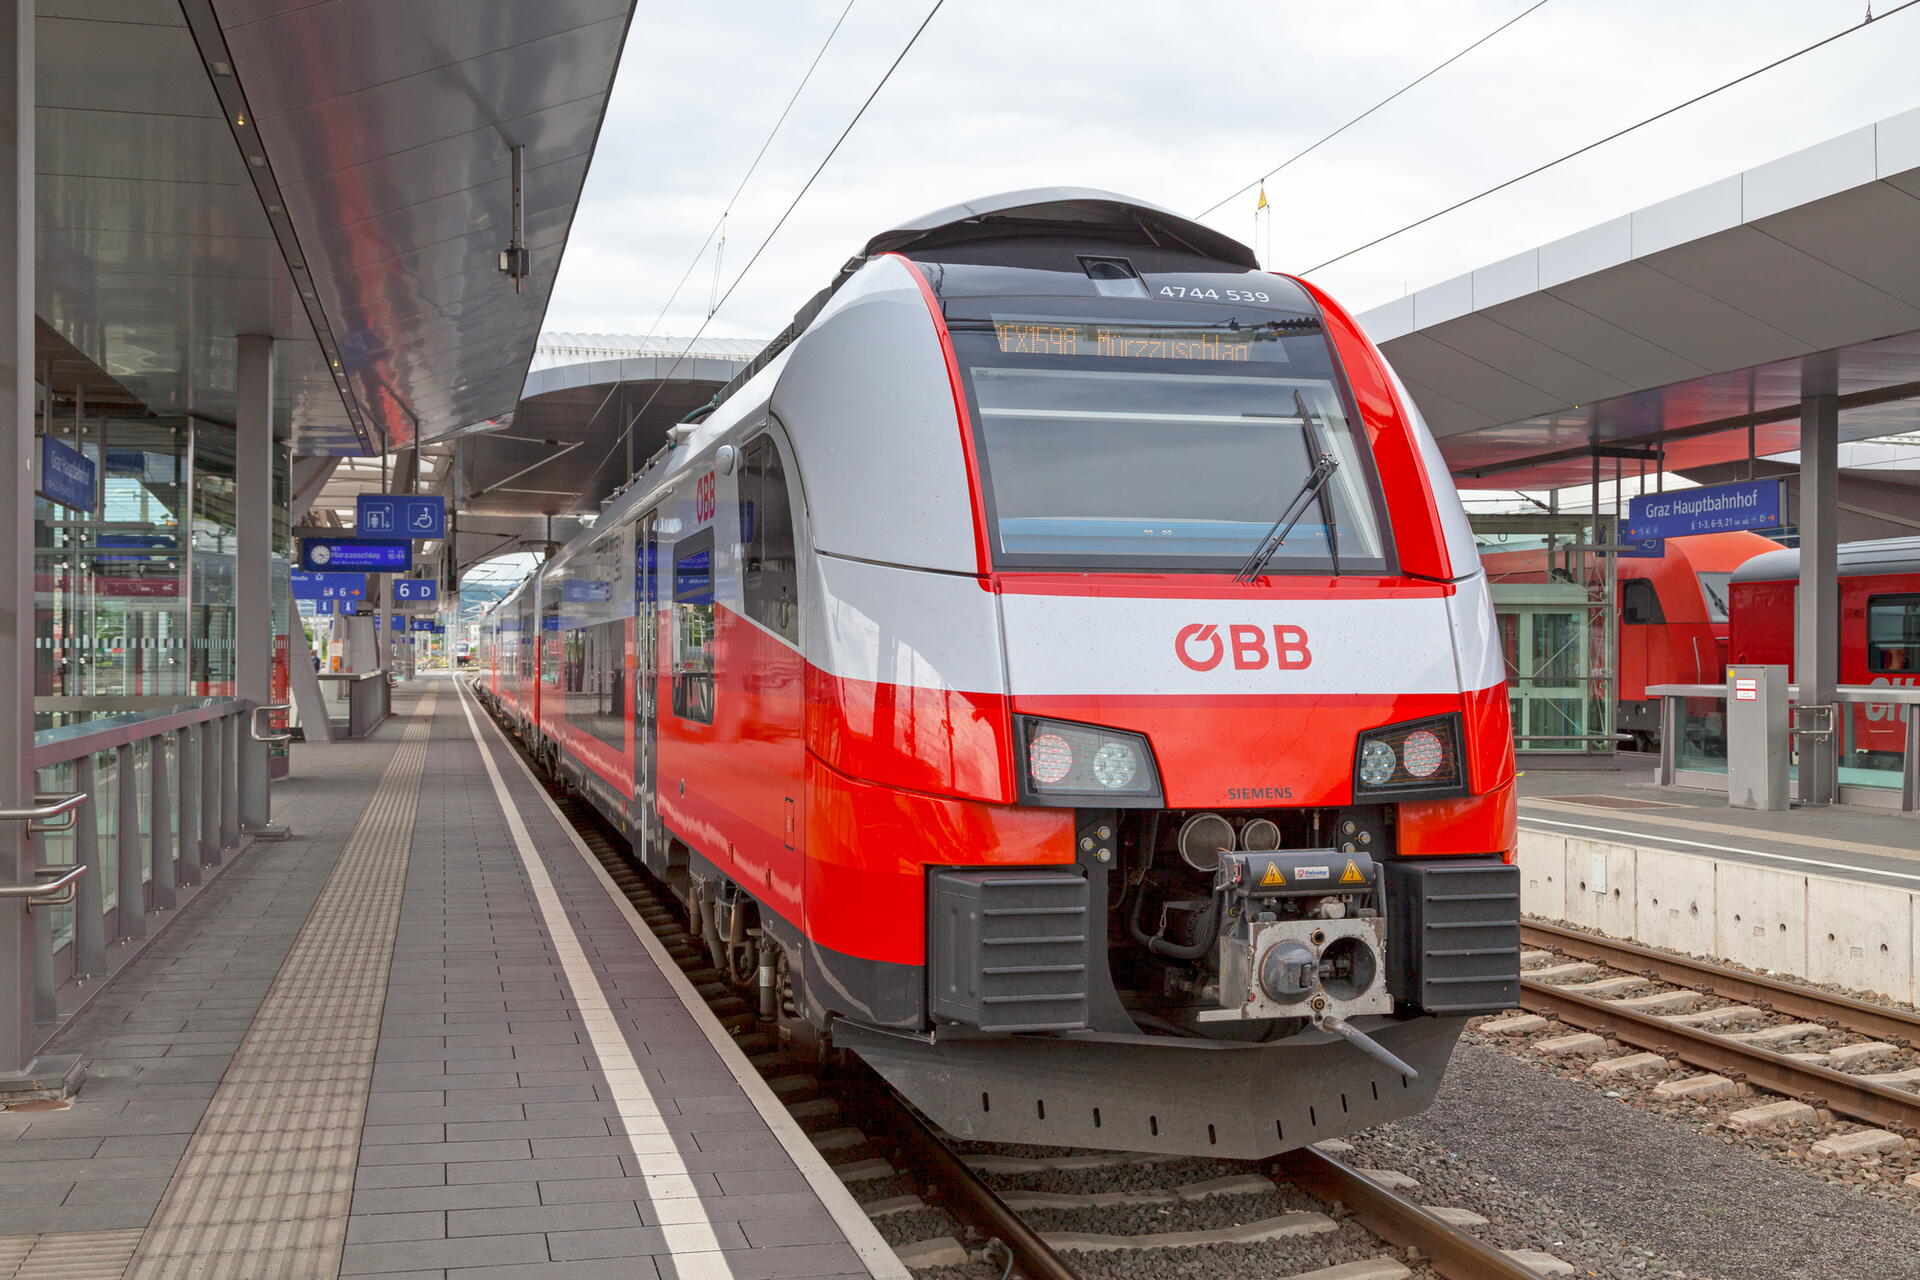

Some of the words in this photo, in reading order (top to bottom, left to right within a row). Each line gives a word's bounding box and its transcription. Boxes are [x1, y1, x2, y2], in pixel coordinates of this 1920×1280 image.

[1160, 286, 1219, 300] 4744
[1226, 290, 1270, 303] 539
[696, 470, 715, 525] ÖBB
[1645, 503, 1671, 519] Graz
[1673, 489, 1759, 517] Hauptbahnhof
[339, 587, 347, 597] 6
[400, 583, 410, 598] 6
[421, 586, 431, 597] D
[413, 621, 420, 630] 6
[1175, 623, 1312, 672] ÖBB
[1228, 787, 1293, 800] SIEMENS
